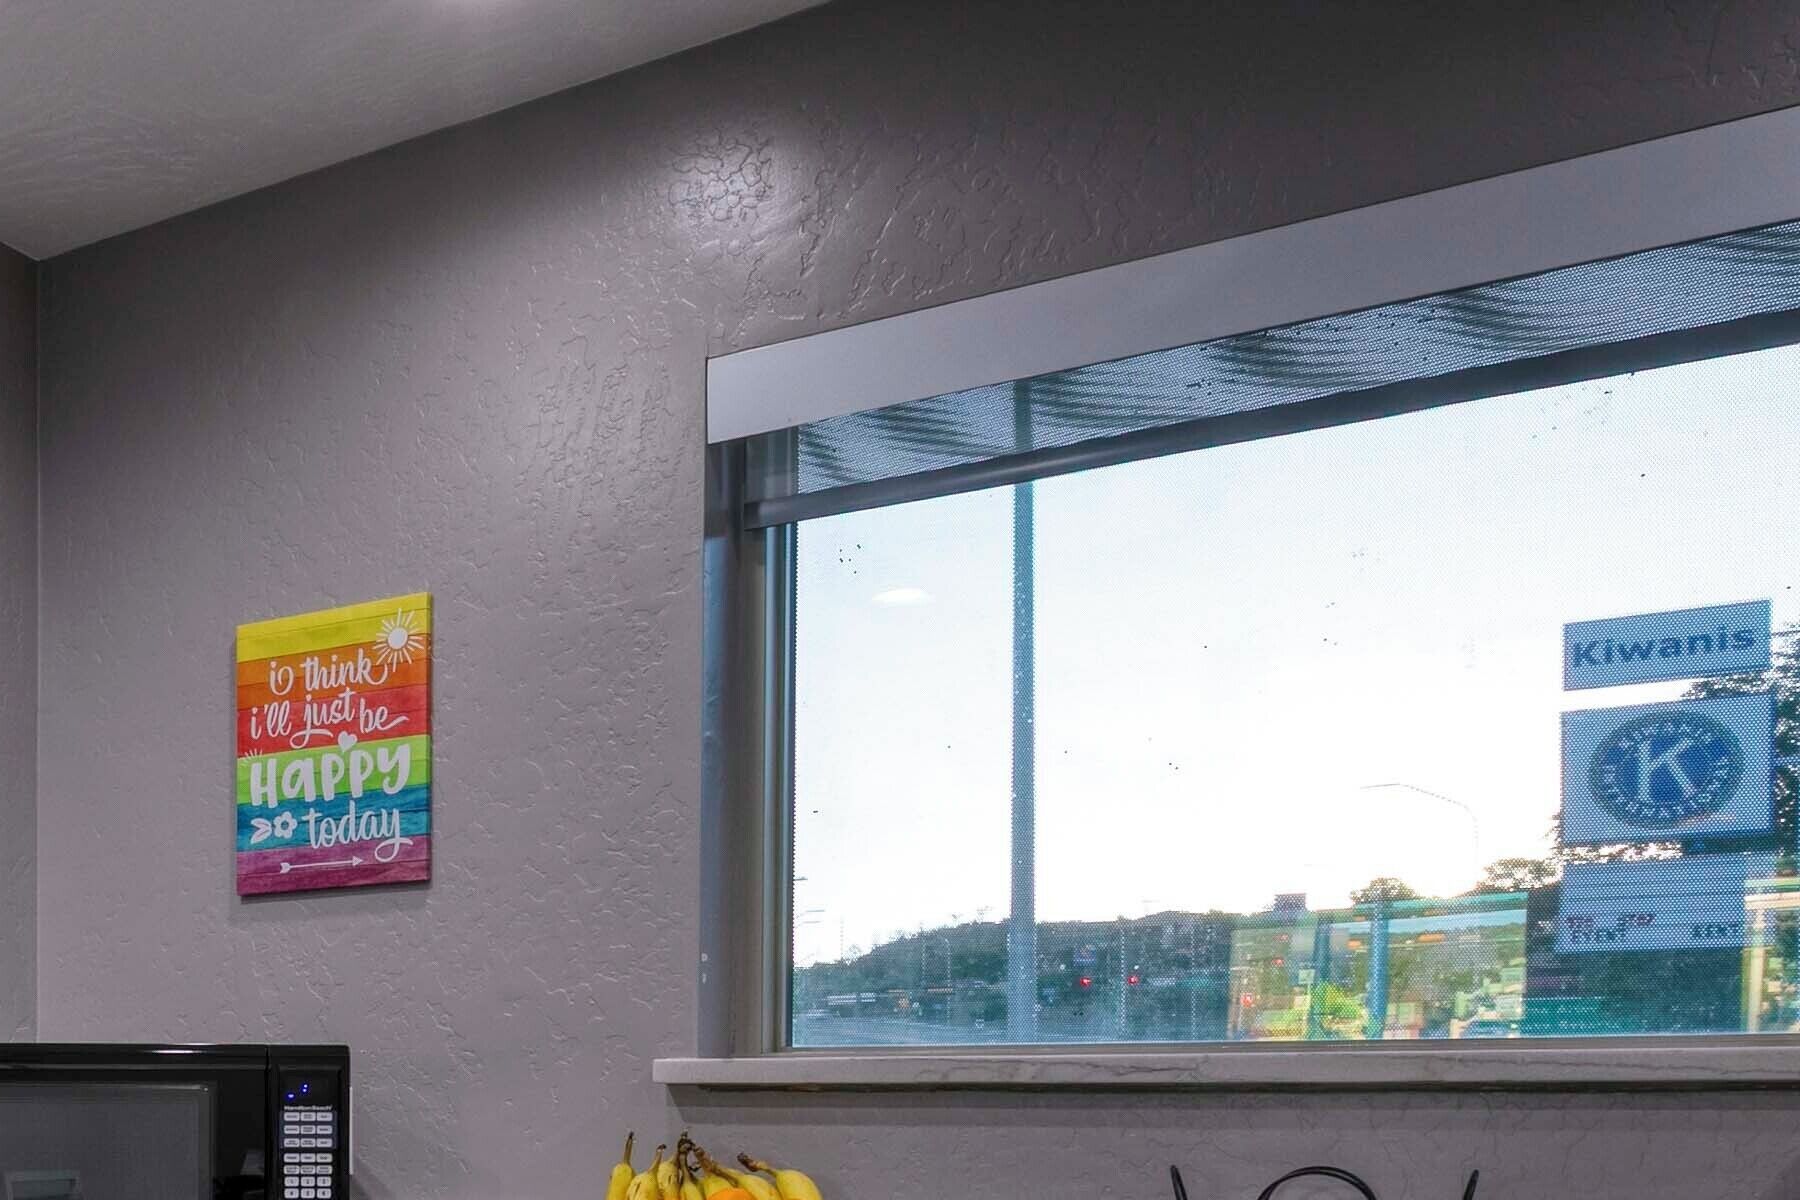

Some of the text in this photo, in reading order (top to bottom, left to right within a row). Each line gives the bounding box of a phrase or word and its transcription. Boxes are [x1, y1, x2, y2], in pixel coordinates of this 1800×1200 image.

[269, 648, 388, 695] i think
[1572, 625, 1757, 667] Kiwanis
[250, 688, 410, 749] i'll just be
[1635, 736, 1699, 804] K
[301, 800, 414, 863] today
